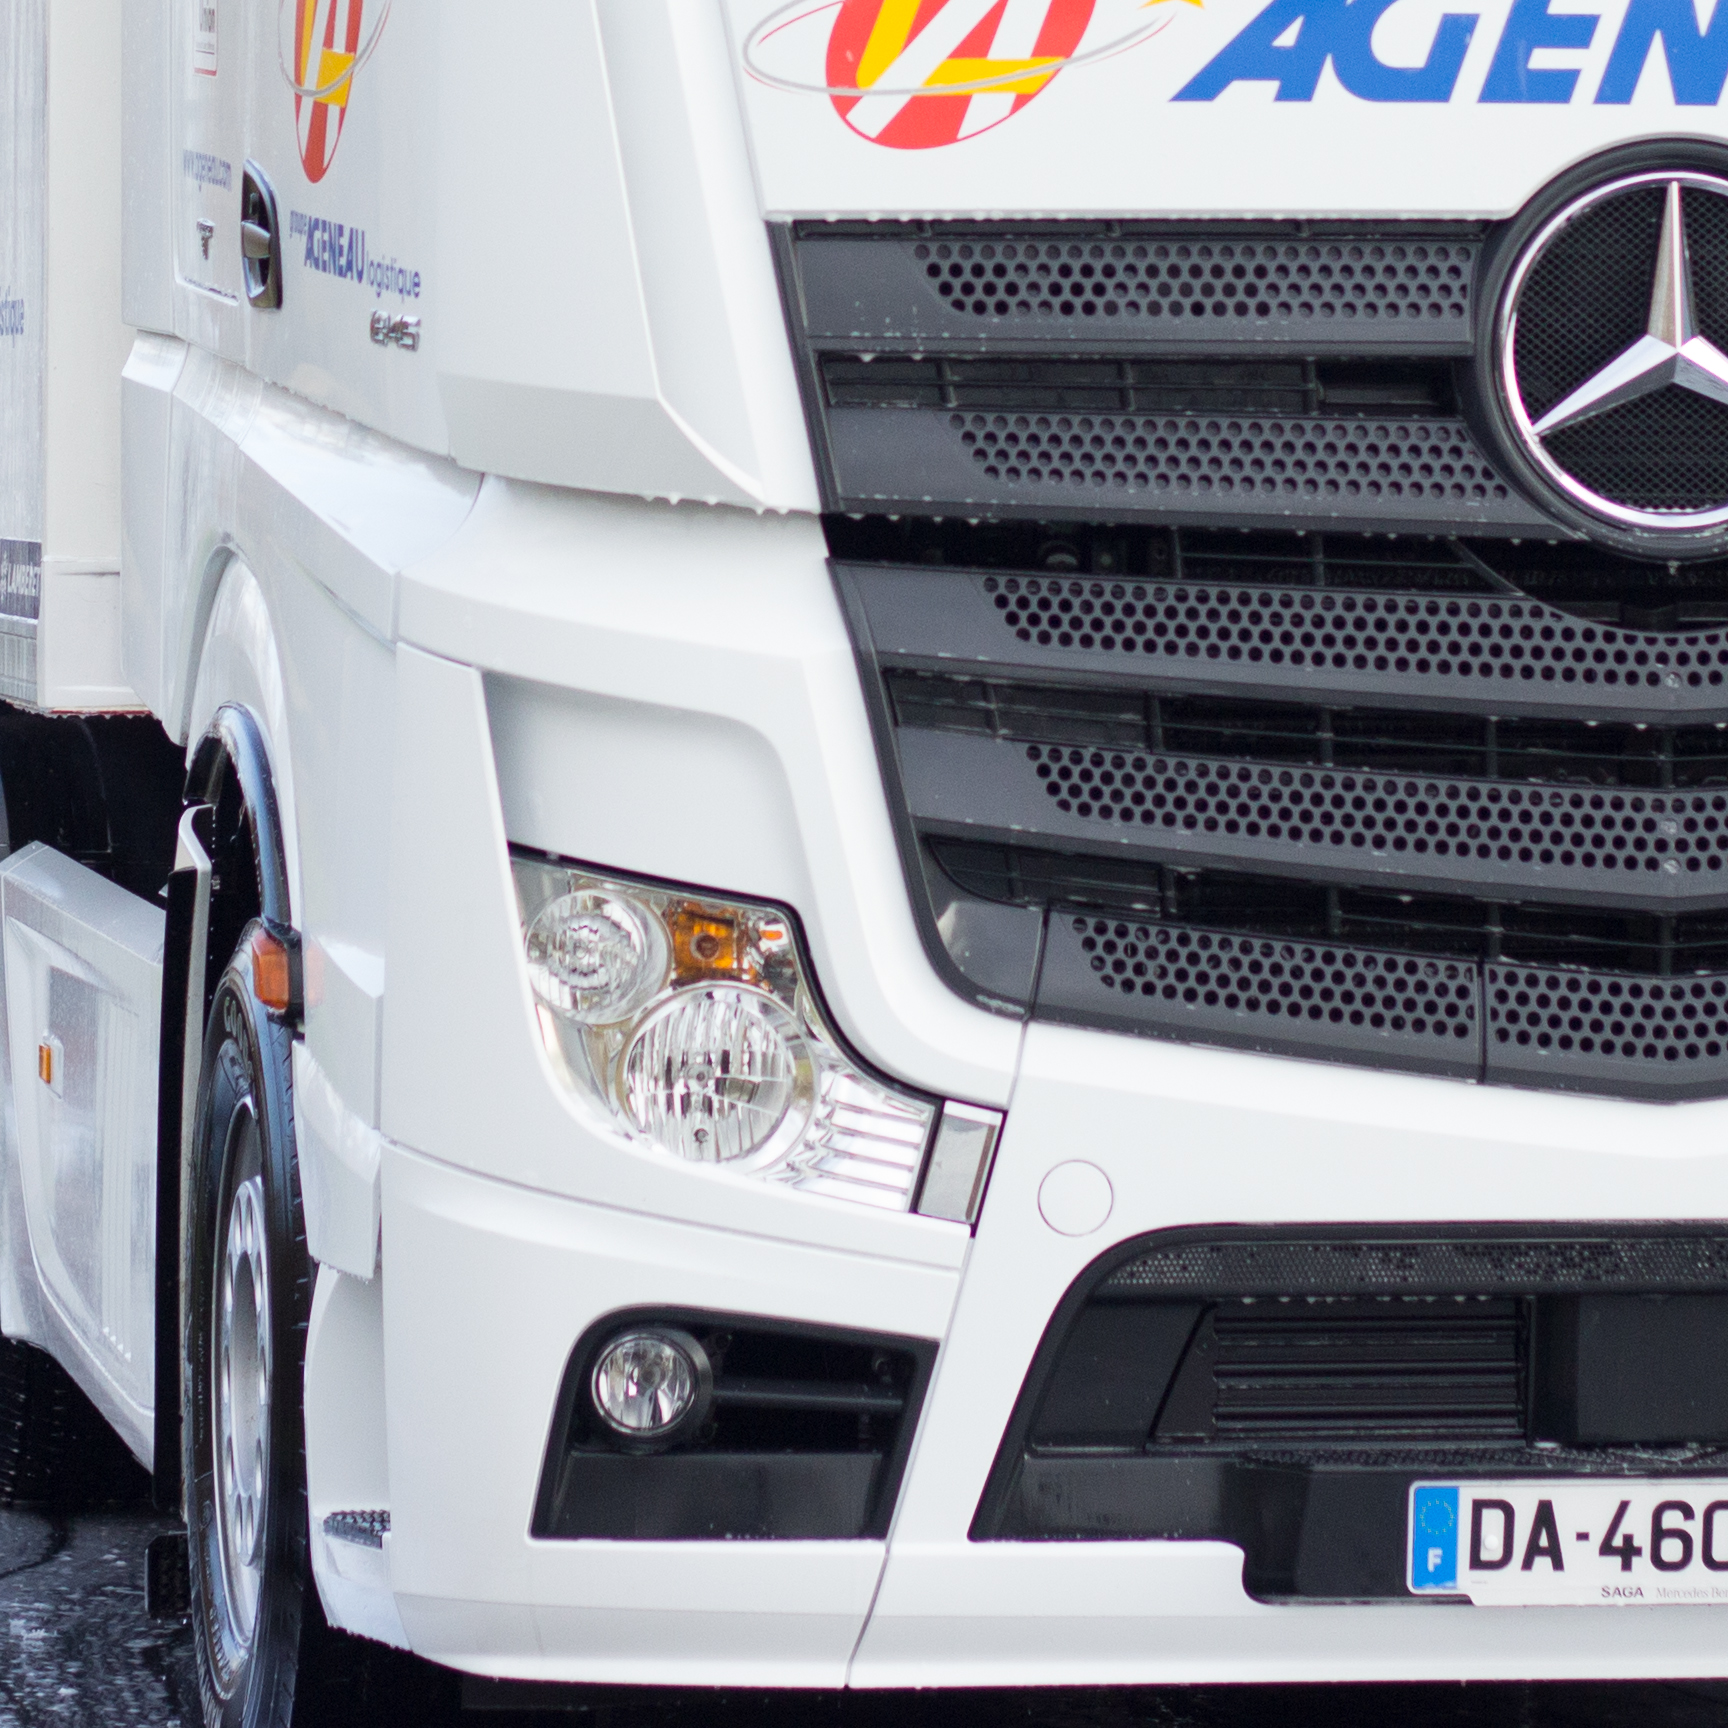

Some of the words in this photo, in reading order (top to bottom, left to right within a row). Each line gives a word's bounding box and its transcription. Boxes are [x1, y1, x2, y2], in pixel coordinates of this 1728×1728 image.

[304, 214, 365, 284] AGENEAU
[366, 249, 421, 303] logistique
[1427, 1547, 1442, 1573] F
[1601, 1585, 1645, 1599] SAGA
